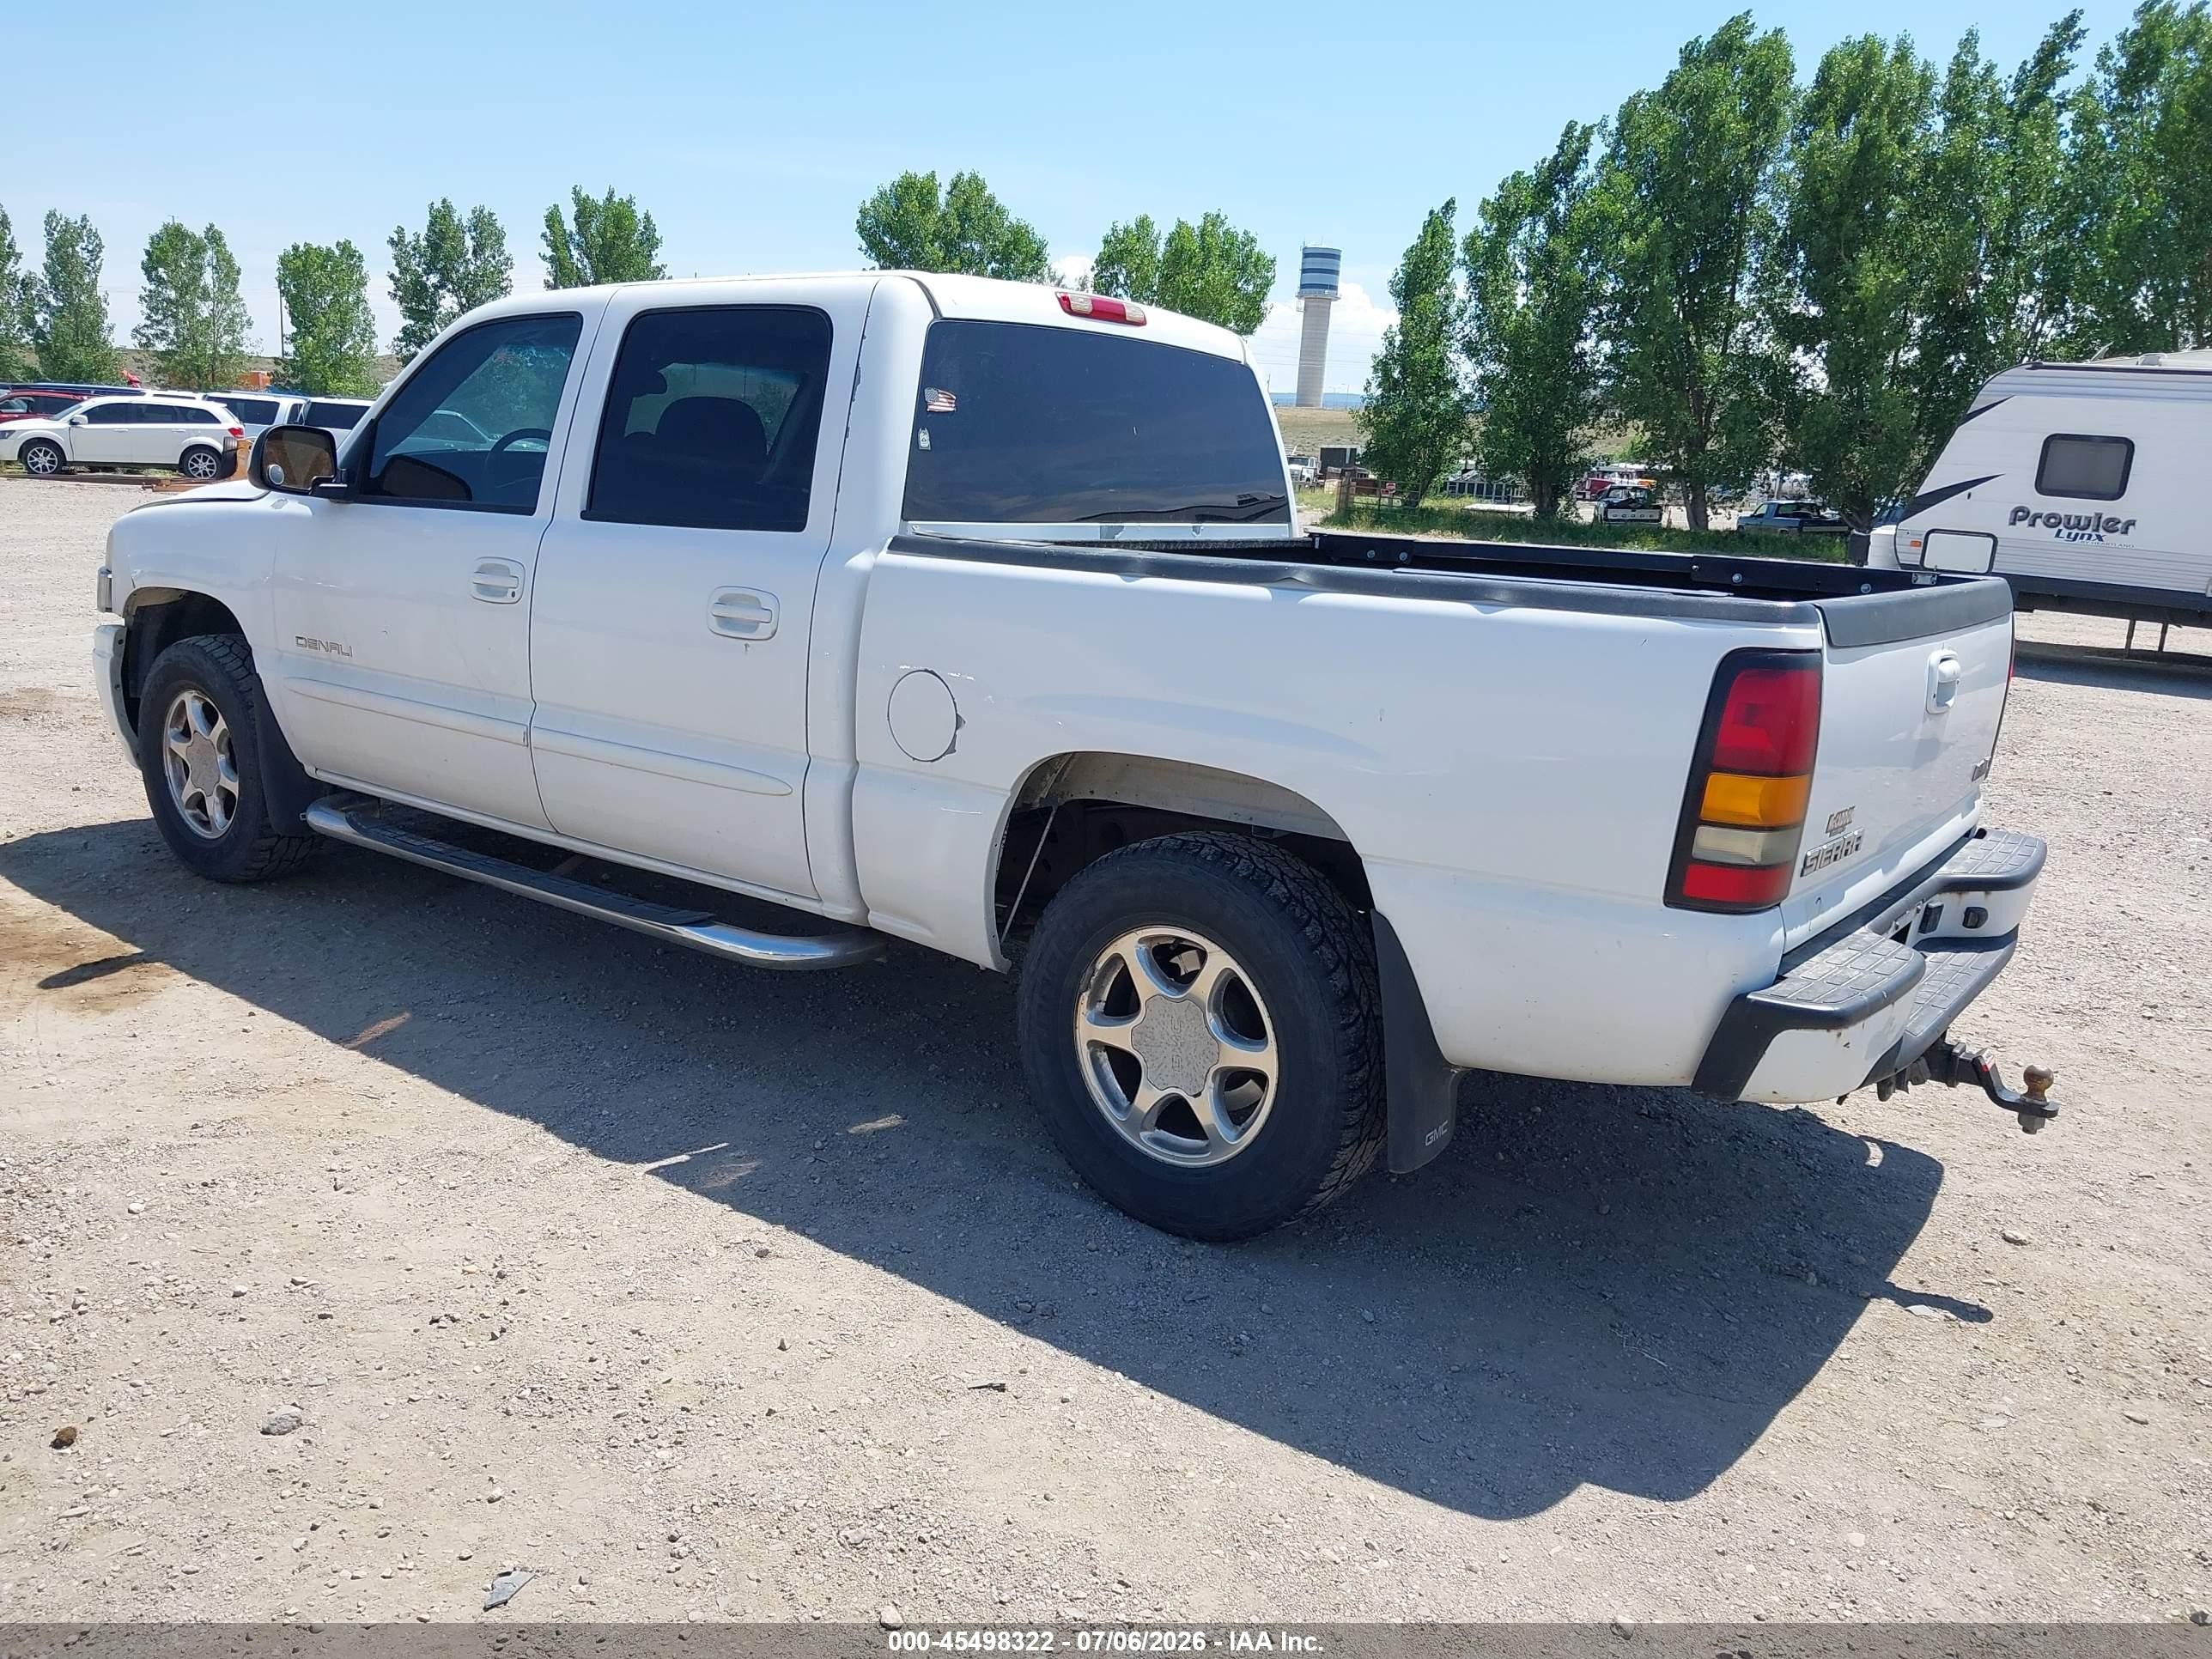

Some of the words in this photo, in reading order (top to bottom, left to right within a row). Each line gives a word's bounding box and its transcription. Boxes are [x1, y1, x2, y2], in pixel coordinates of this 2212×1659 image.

[2008, 505, 2137, 535] Prowler
[2054, 528, 2107, 543] Lynx
[295, 635, 353, 658] DENALI
[1800, 827, 1865, 878] SIERRA
[1425, 1120, 1449, 1146] GMC
